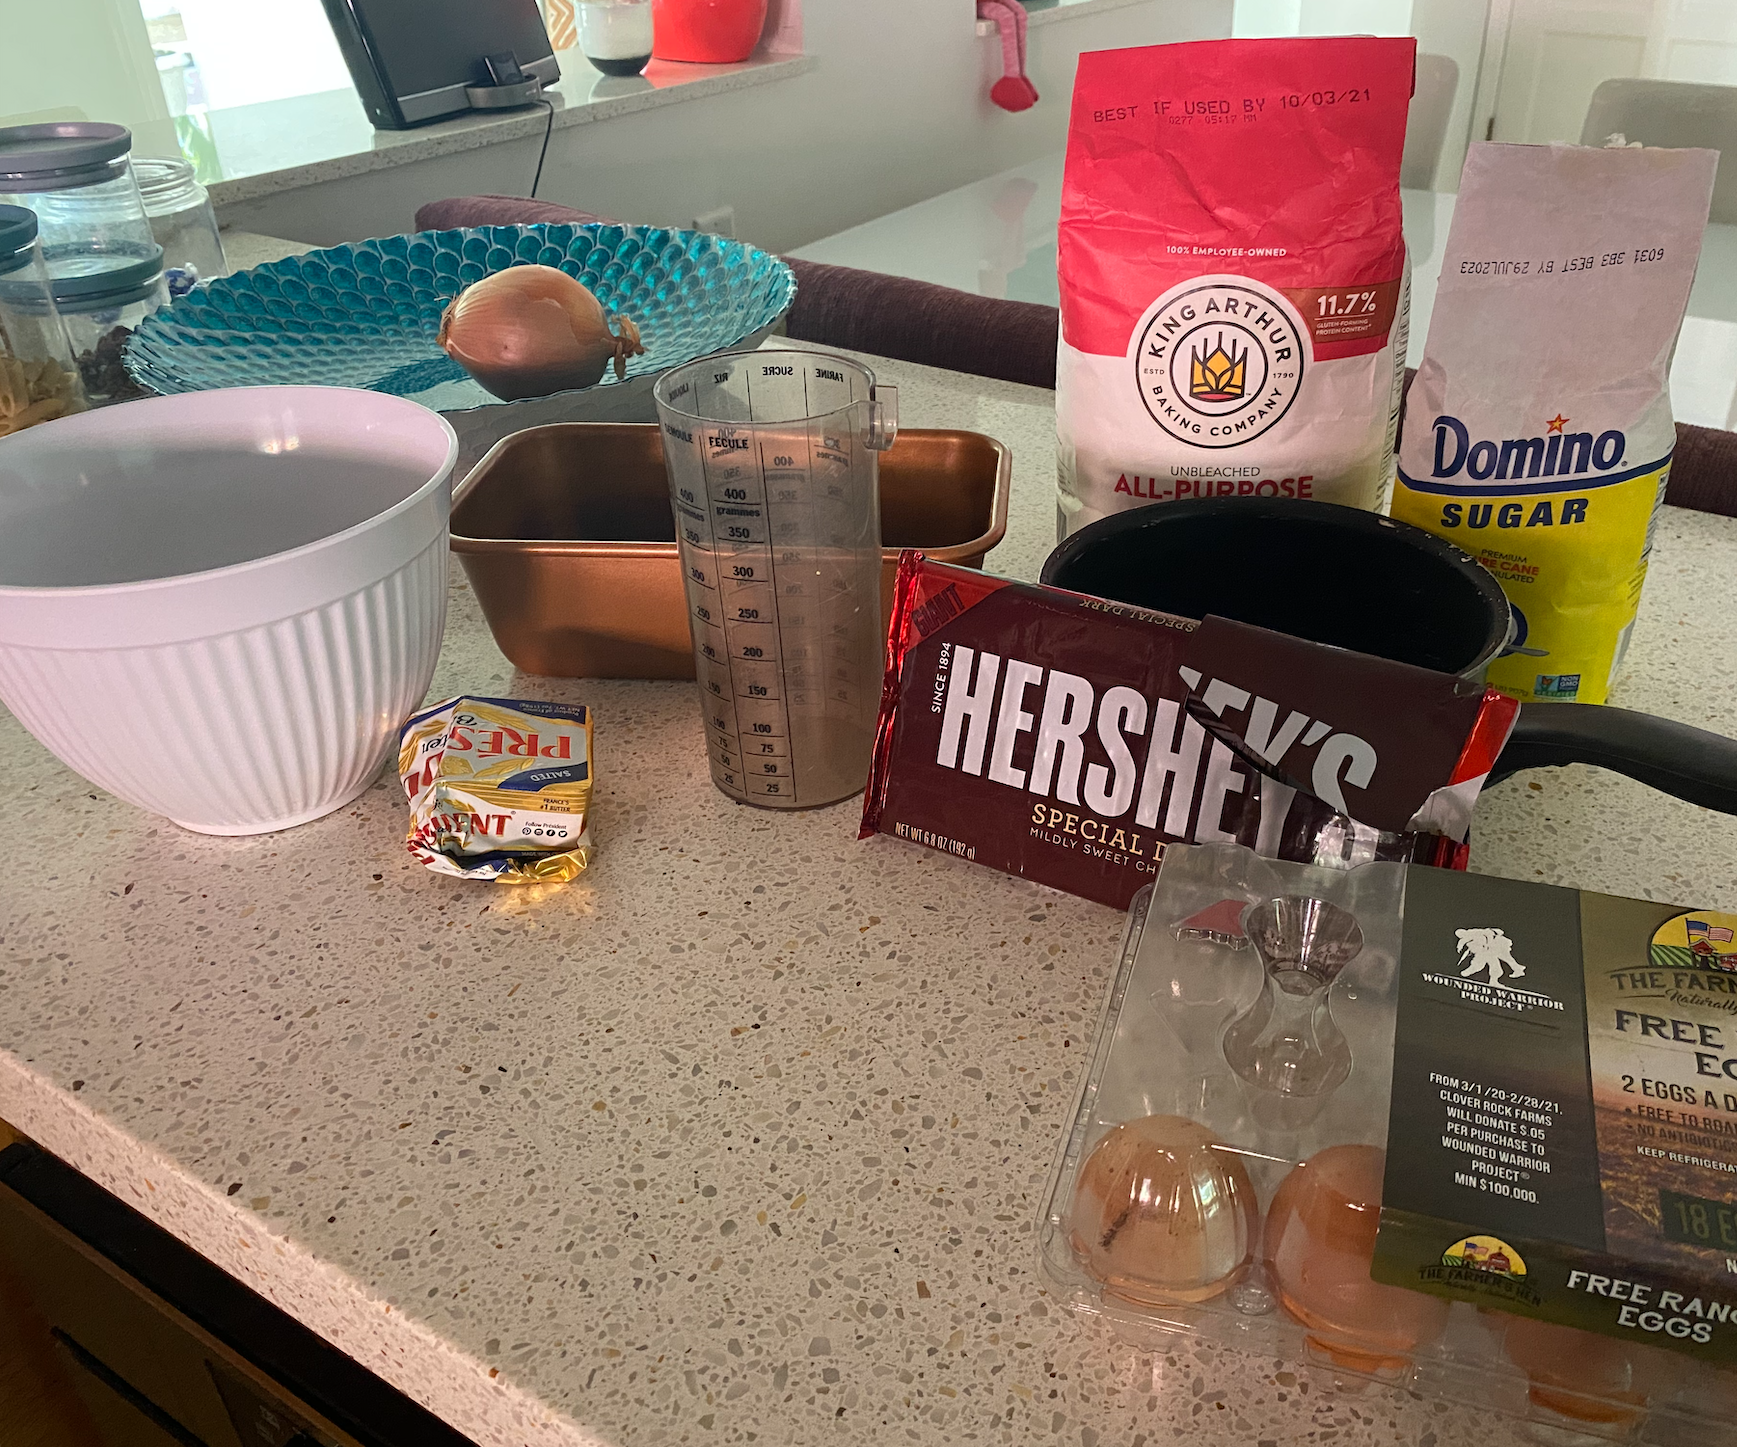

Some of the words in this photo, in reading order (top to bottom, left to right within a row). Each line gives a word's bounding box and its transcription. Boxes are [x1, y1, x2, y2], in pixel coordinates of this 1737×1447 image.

[1094, 106, 1139, 123] BEST
[1154, 101, 1171, 115] IF
[1185, 100, 1230, 114] USED
[1243, 98, 1265, 112] BY
[1280, 89, 1371, 107] 10/03/21
[1169, 116, 1193, 125] 0277
[1166, 246, 1189, 254] 100%
[1192, 246, 1287, 257] EMPLOYEE-OWNED
[1633, 248, 1664, 264] 6031
[1460, 261, 1530, 275] 29JUL2023
[1537, 261, 1554, 273] BY
[1561, 256, 1594, 273] BEST
[1317, 291, 1376, 316] 11.7%
[1148, 304, 1196, 358] KING
[1205, 297, 1292, 364] ARTHUR
[1315, 327, 1341, 336] PROTEIN
[1152, 385, 1202, 434] BAKING
[1210, 388, 1283, 436] COMPANY
[709, 436, 749, 450] FECULE
[1431, 414, 1626, 481] Domino
[1170, 466, 1261, 477] UNBLEACHED
[724, 488, 746, 500] 400
[1114, 473, 1313, 500] ALL-PURPOSE
[680, 488, 694, 503] 400
[716, 507, 760, 517] grammes
[1440, 498, 1589, 529] SUGAR
[685, 528, 700, 543] 350
[728, 526, 750, 539] 350
[1482, 549, 1527, 563] PREMIUM
[691, 567, 705, 582] 300
[732, 566, 754, 578] 300
[1501, 561, 1540, 576] CANE
[1491, 570, 1535, 584] NULATED
[696, 605, 710, 620] 250
[738, 608, 758, 620] 250
[912, 582, 965, 637] GIANT
[1080, 599, 1124, 616] DARK
[1129, 609, 1196, 632] SPECIAL
[702, 643, 715, 658] 200
[743, 647, 763, 658] 200
[931, 673, 947, 713] SINCE
[939, 642, 952, 670] 1894
[707, 680, 721, 695] 150
[747, 686, 767, 697] 150
[712, 716, 726, 730] 100
[752, 723, 771, 734] 100
[718, 737, 728, 748] 75
[760, 744, 774, 754] 75
[721, 755, 730, 766] 50
[936, 644, 1378, 869] HERSHEY'S
[530, 770, 572, 782] SALTED
[763, 764, 777, 774] 50
[724, 774, 733, 785] 25
[766, 784, 779, 793] 25
[543, 798, 569, 806] FRANCE'S
[1031, 803, 1143, 856] SPECIAL
[895, 822, 909, 838] NET
[911, 826, 923, 842] WT
[937, 836, 948, 851] OZ
[949, 839, 966, 857] (192
[1030, 827, 1078, 849] MILDLY
[1083, 844, 1130, 866] SWEET
[1610, 972, 1666, 991] THE
[1422, 973, 1491, 995] WOUNDED
[1496, 989, 1564, 1011] WARRIOR
[1461, 990, 1525, 1012] PROJECT
[1614, 1009, 1725, 1050] FREE
[1430, 1072, 1459, 1089] FROM
[1621, 1075, 1635, 1093] 2
[1641, 1078, 1697, 1105] EGGS
[1704, 1090, 1719, 1110] A
[1440, 1089, 1481, 1109] CLOVER
[1483, 1100, 1513, 1117] ROCK
[1515, 1109, 1553, 1127] FARMS
[1447, 1106, 1473, 1123] WILL
[1475, 1113, 1518, 1134] DONATE
[1520, 1124, 1545, 1141] $.05
[1638, 1104, 1674, 1122] FREE
[1679, 1112, 1699, 1128] TO
[1637, 1123, 1655, 1137] NO
[1447, 1121, 1468, 1137] PER
[1470, 1128, 1528, 1152] PURCHASE
[1530, 1143, 1545, 1156] TO
[1442, 1135, 1497, 1160] WOUNDED
[1499, 1151, 1551, 1174] WARRIOR
[1637, 1145, 1666, 1159] KEEP
[1471, 1160, 1520, 1182] PROJECT
[1454, 1172, 1477, 1189] MIN
[1674, 1200, 1710, 1239] 18
[1419, 1267, 1445, 1280] THE
[1566, 1269, 1652, 1305] FREE
[1616, 1304, 1713, 1344] EGGS
